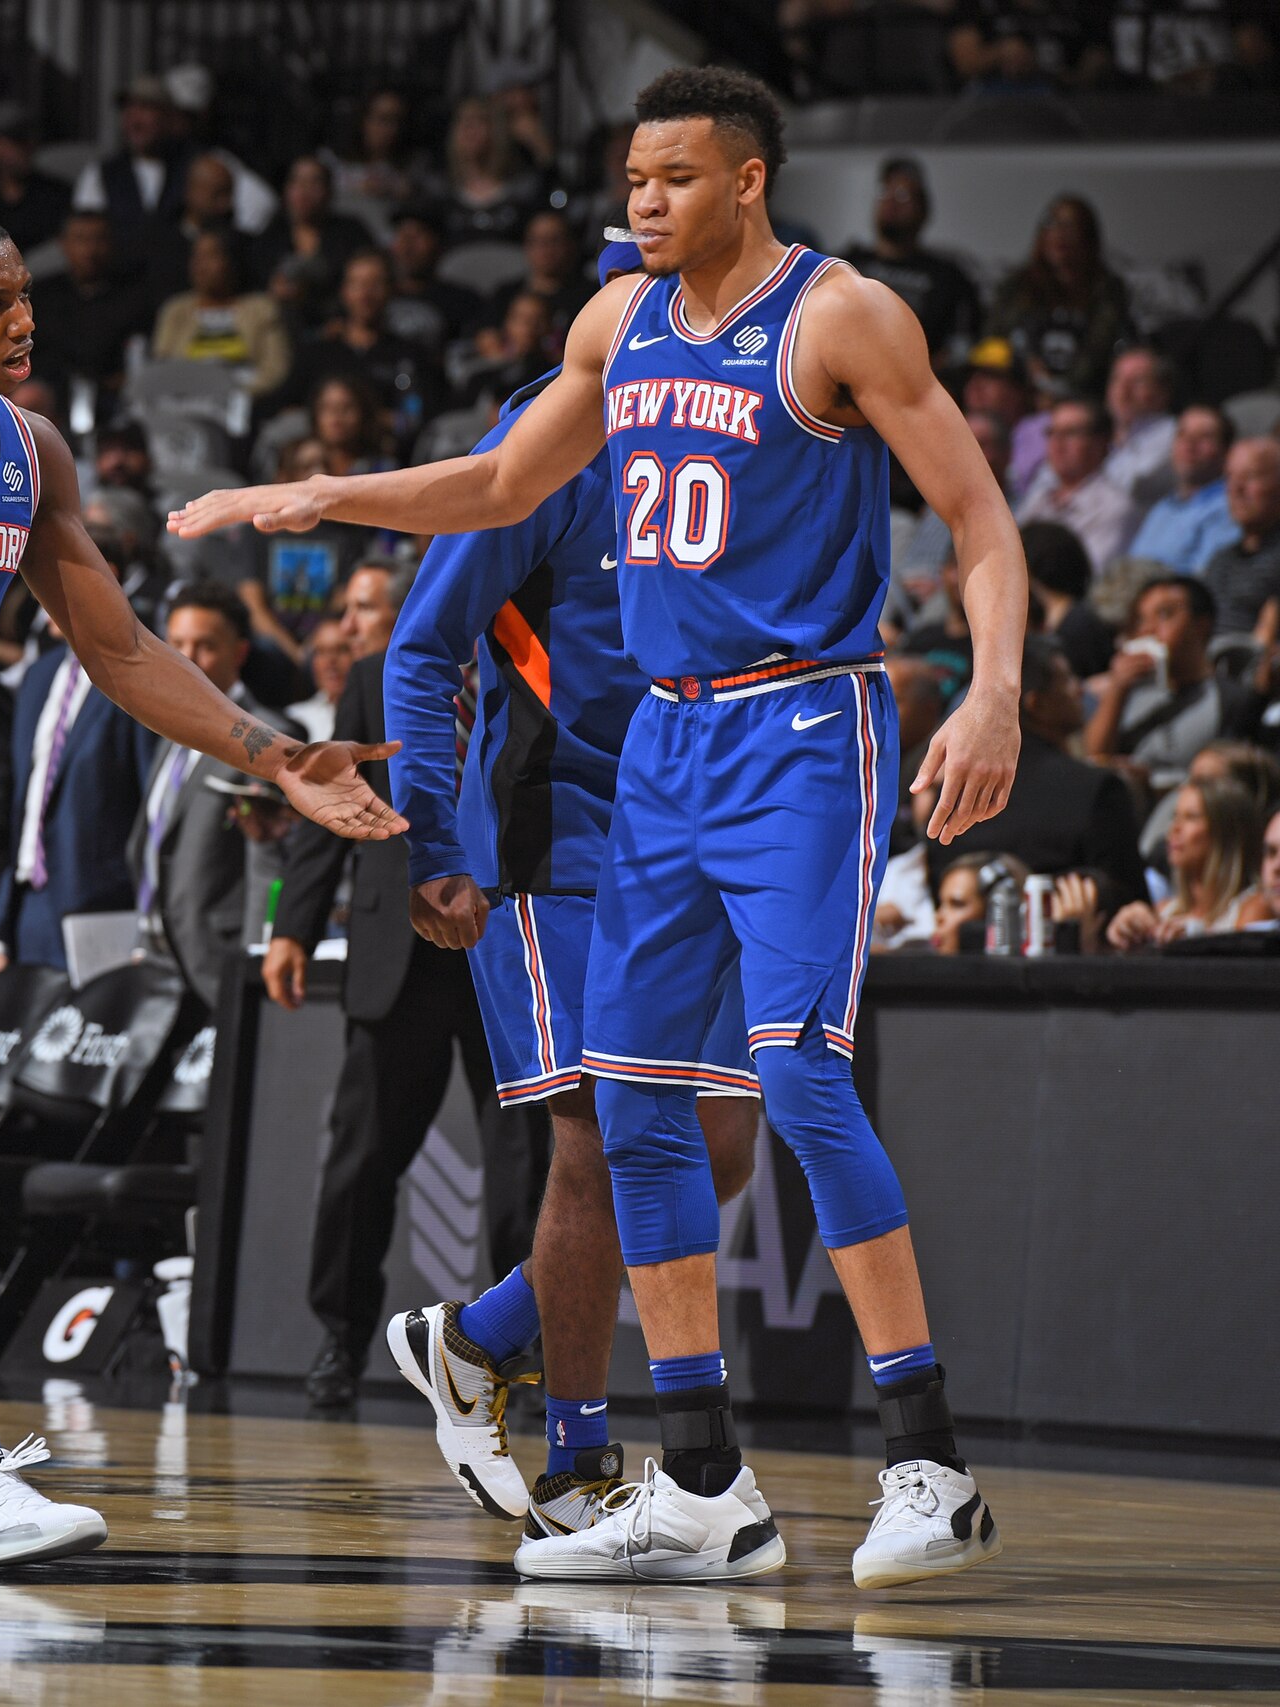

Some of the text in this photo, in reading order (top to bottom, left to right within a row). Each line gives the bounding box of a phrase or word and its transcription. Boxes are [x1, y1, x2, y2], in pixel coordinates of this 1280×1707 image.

[721, 358, 769, 367] SQUARESPACE
[607, 378, 764, 446] NEW YORK
[623, 450, 730, 570] 20
